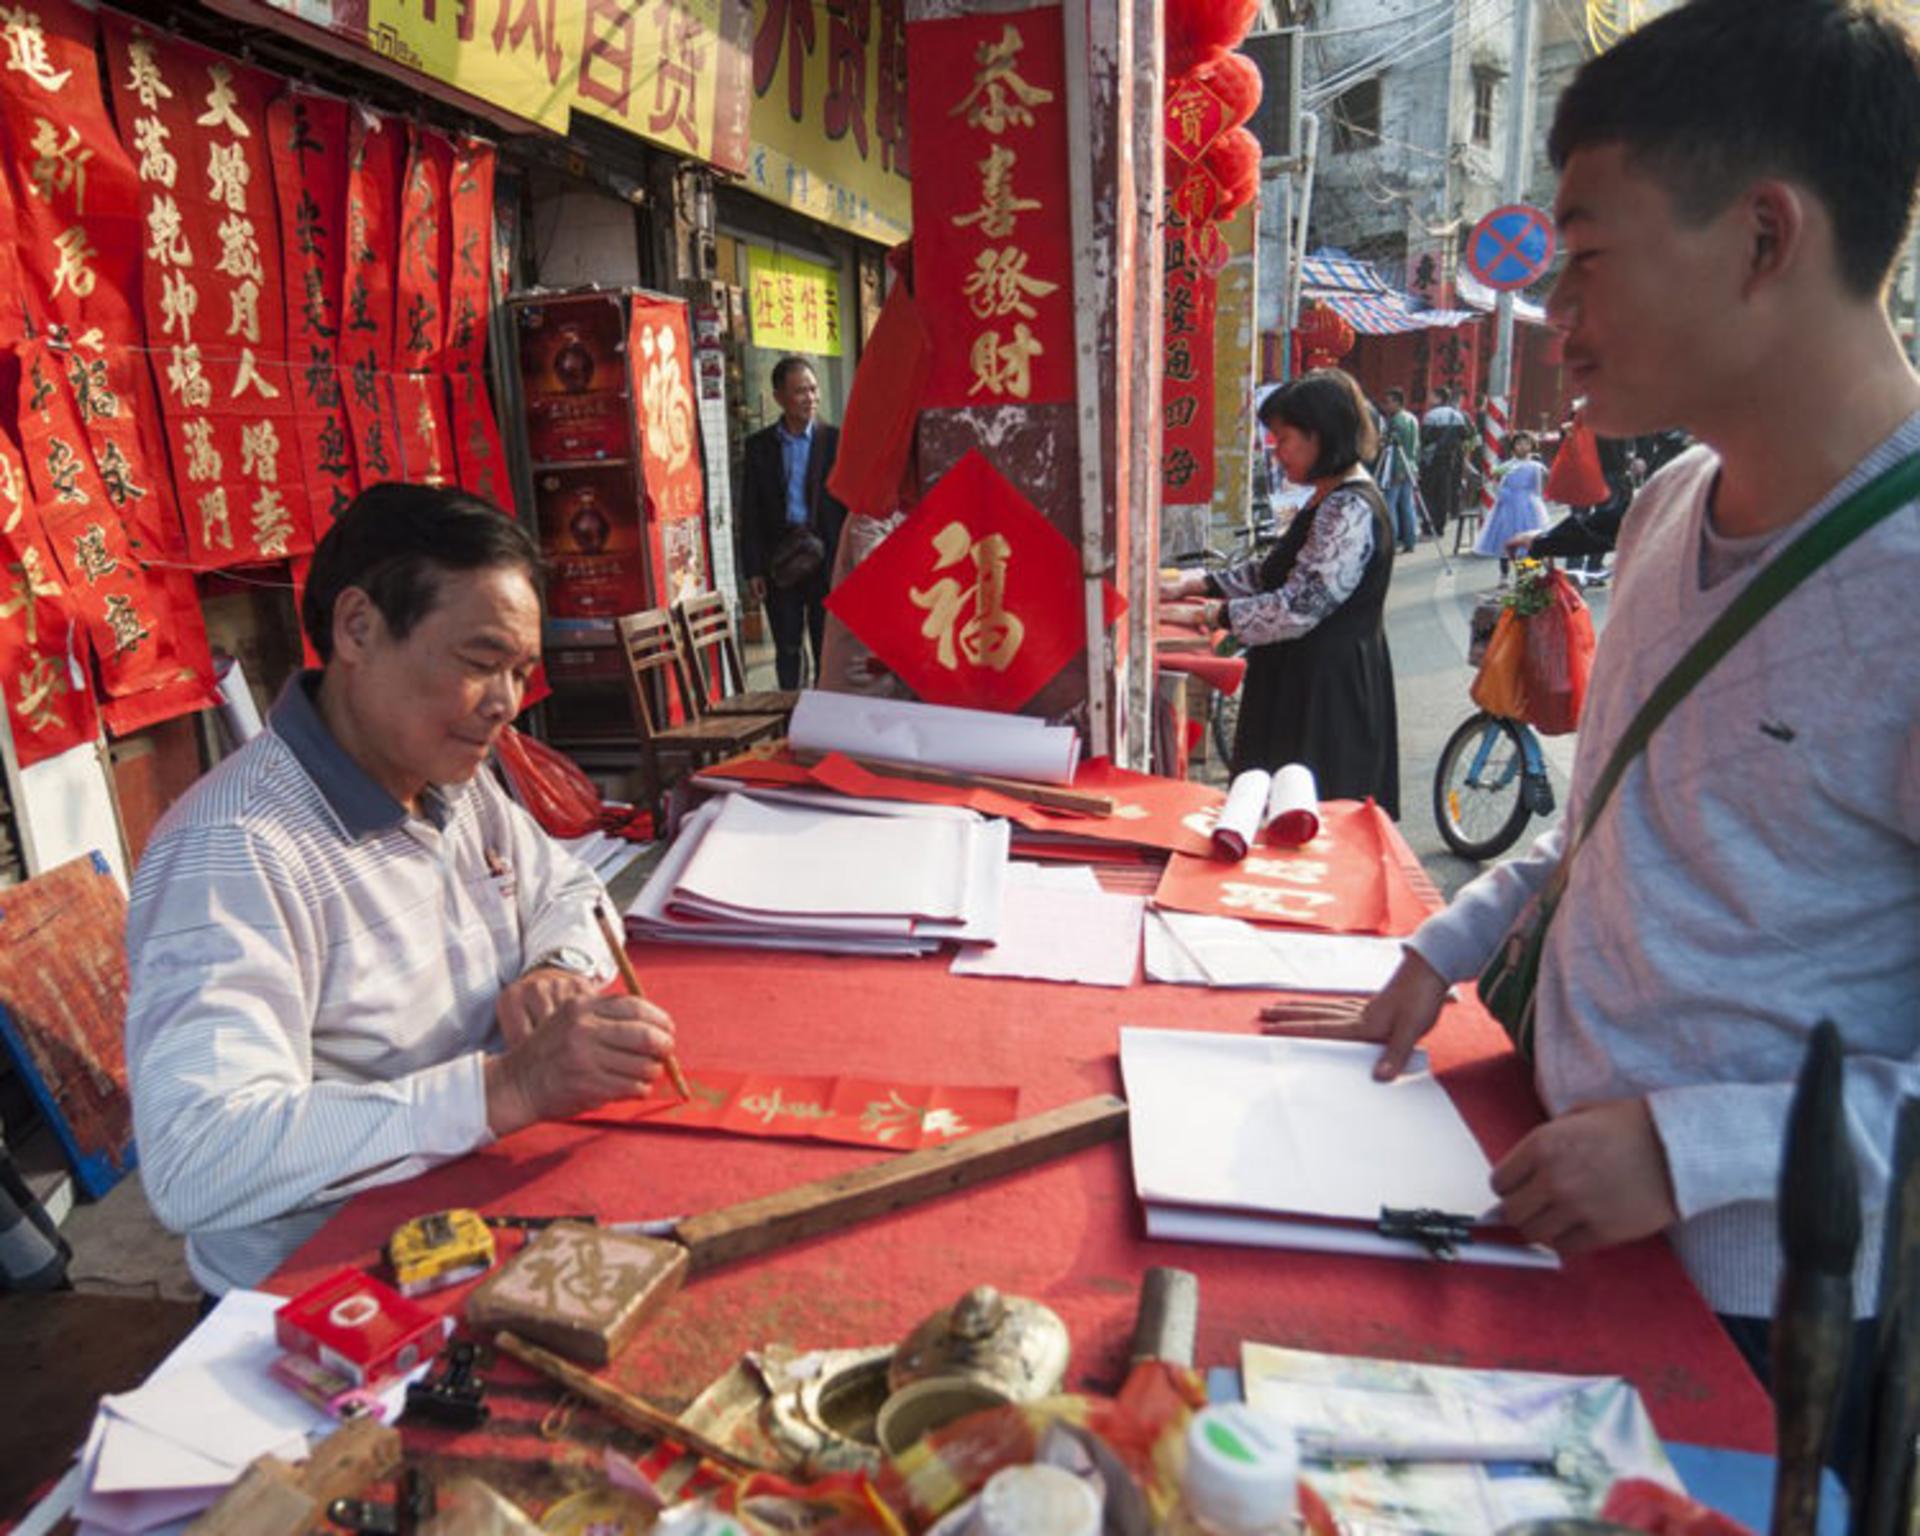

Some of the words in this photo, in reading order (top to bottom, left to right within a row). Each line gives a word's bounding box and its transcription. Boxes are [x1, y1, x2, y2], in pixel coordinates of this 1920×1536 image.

[948, 25, 1059, 399] 恭喜發財
[909, 520, 1025, 672] 福
